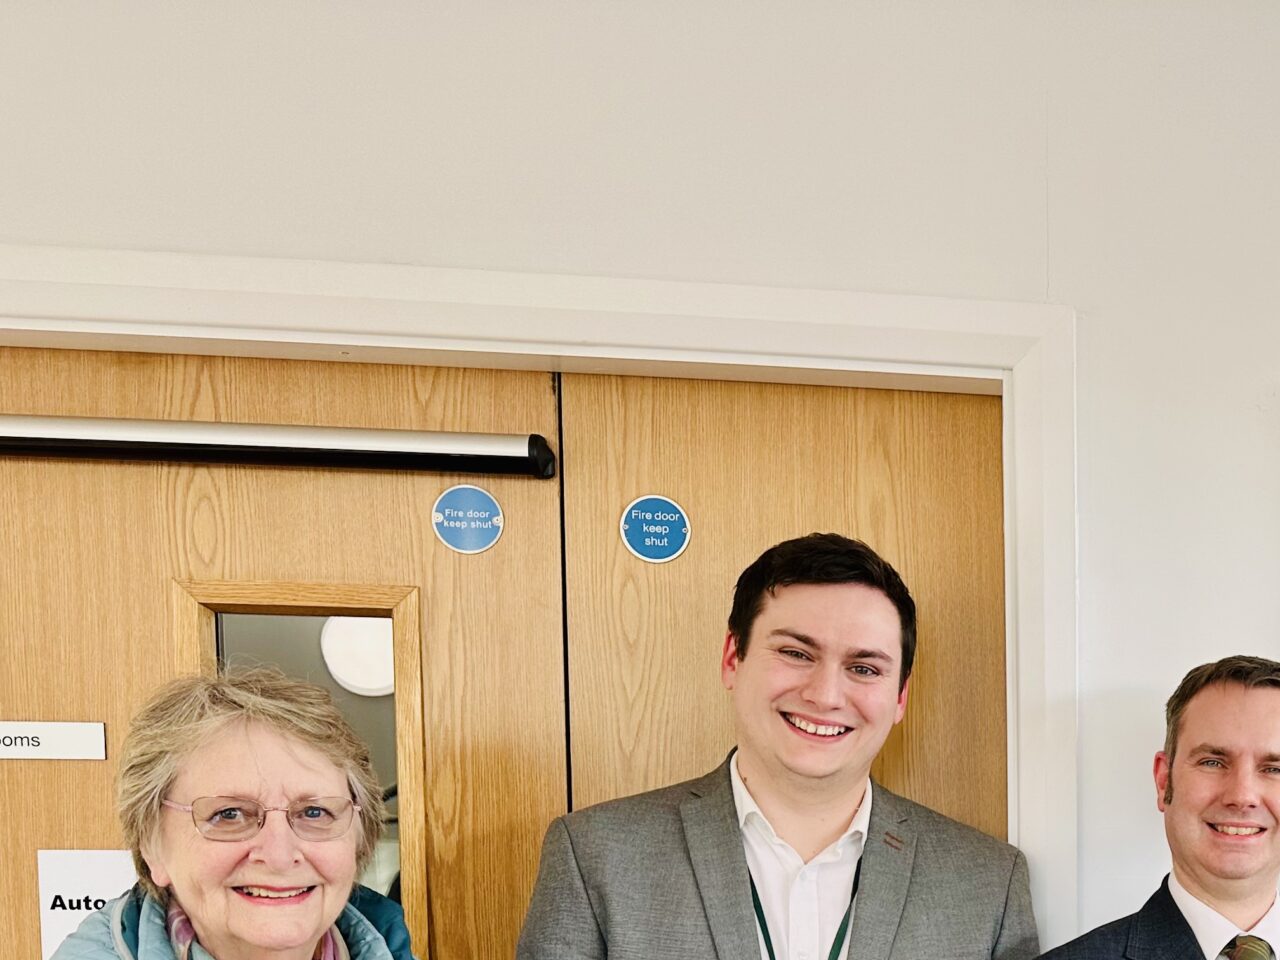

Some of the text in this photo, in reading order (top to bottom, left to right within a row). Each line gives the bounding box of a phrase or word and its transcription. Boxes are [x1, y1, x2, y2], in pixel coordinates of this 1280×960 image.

[445, 509, 490, 518] Fire door
[631, 510, 680, 521] Fire door
[443, 519, 492, 529] keep shut
[642, 523, 669, 535] keep
[644, 537, 668, 546] shut
[0, 735, 41, 747] oms
